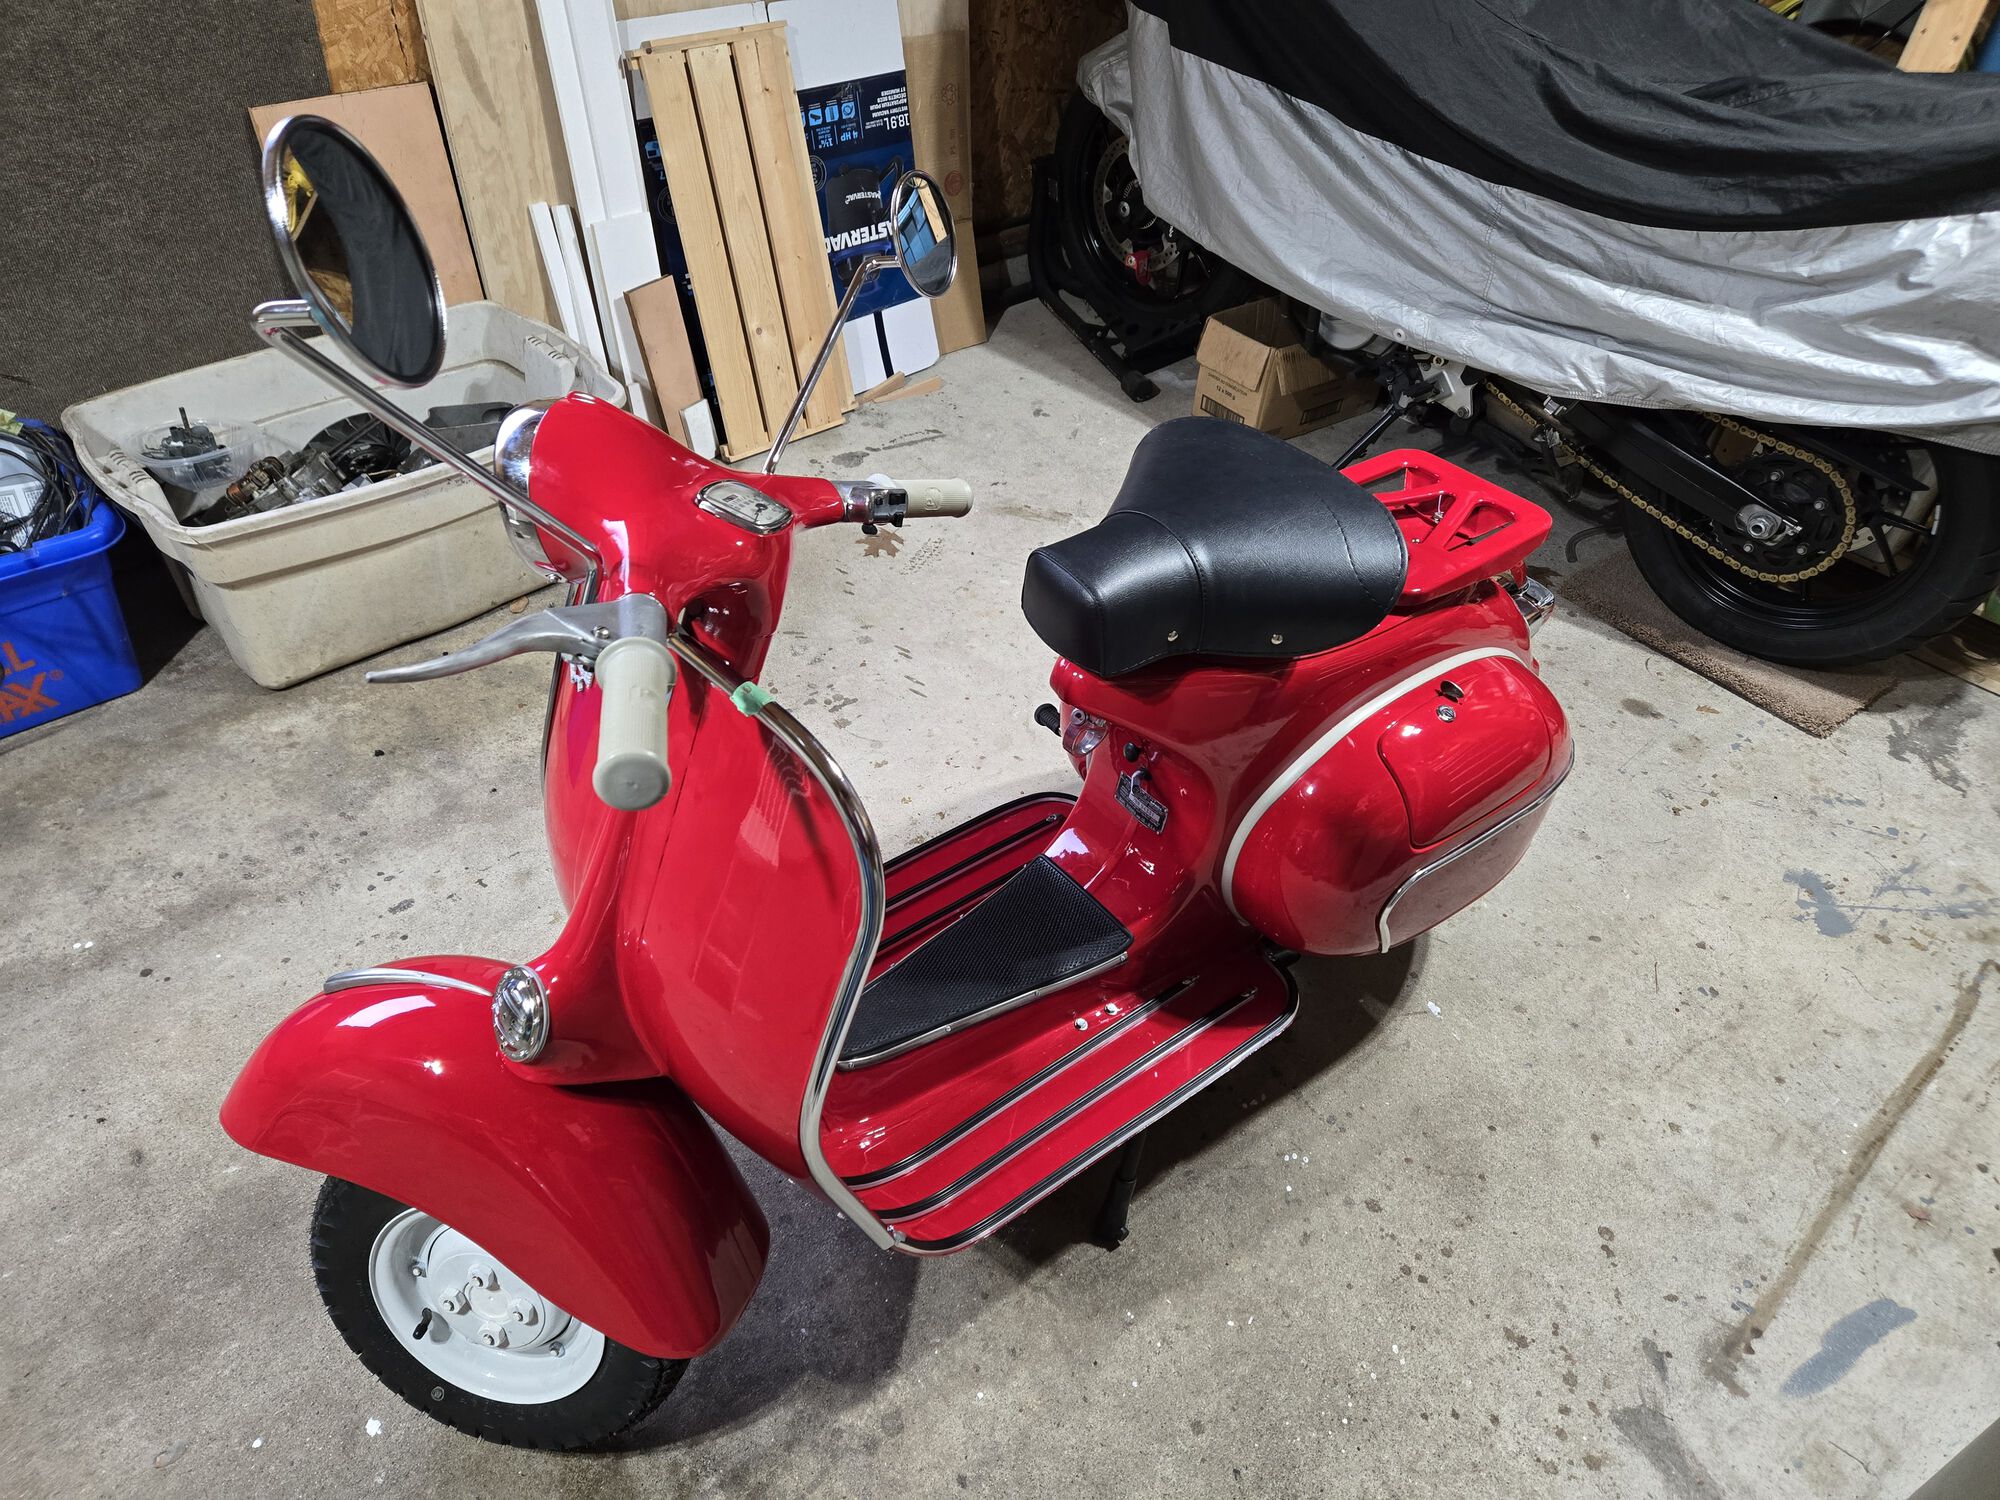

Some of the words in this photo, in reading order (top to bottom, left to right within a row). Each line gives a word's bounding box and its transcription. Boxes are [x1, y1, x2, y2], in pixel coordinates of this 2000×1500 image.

[884, 117, 891, 131] L
[890, 113, 910, 130] 18.9
[841, 131, 852, 142] HP
[852, 130, 859, 140] 4
[824, 220, 894, 253] ASTERVAC
